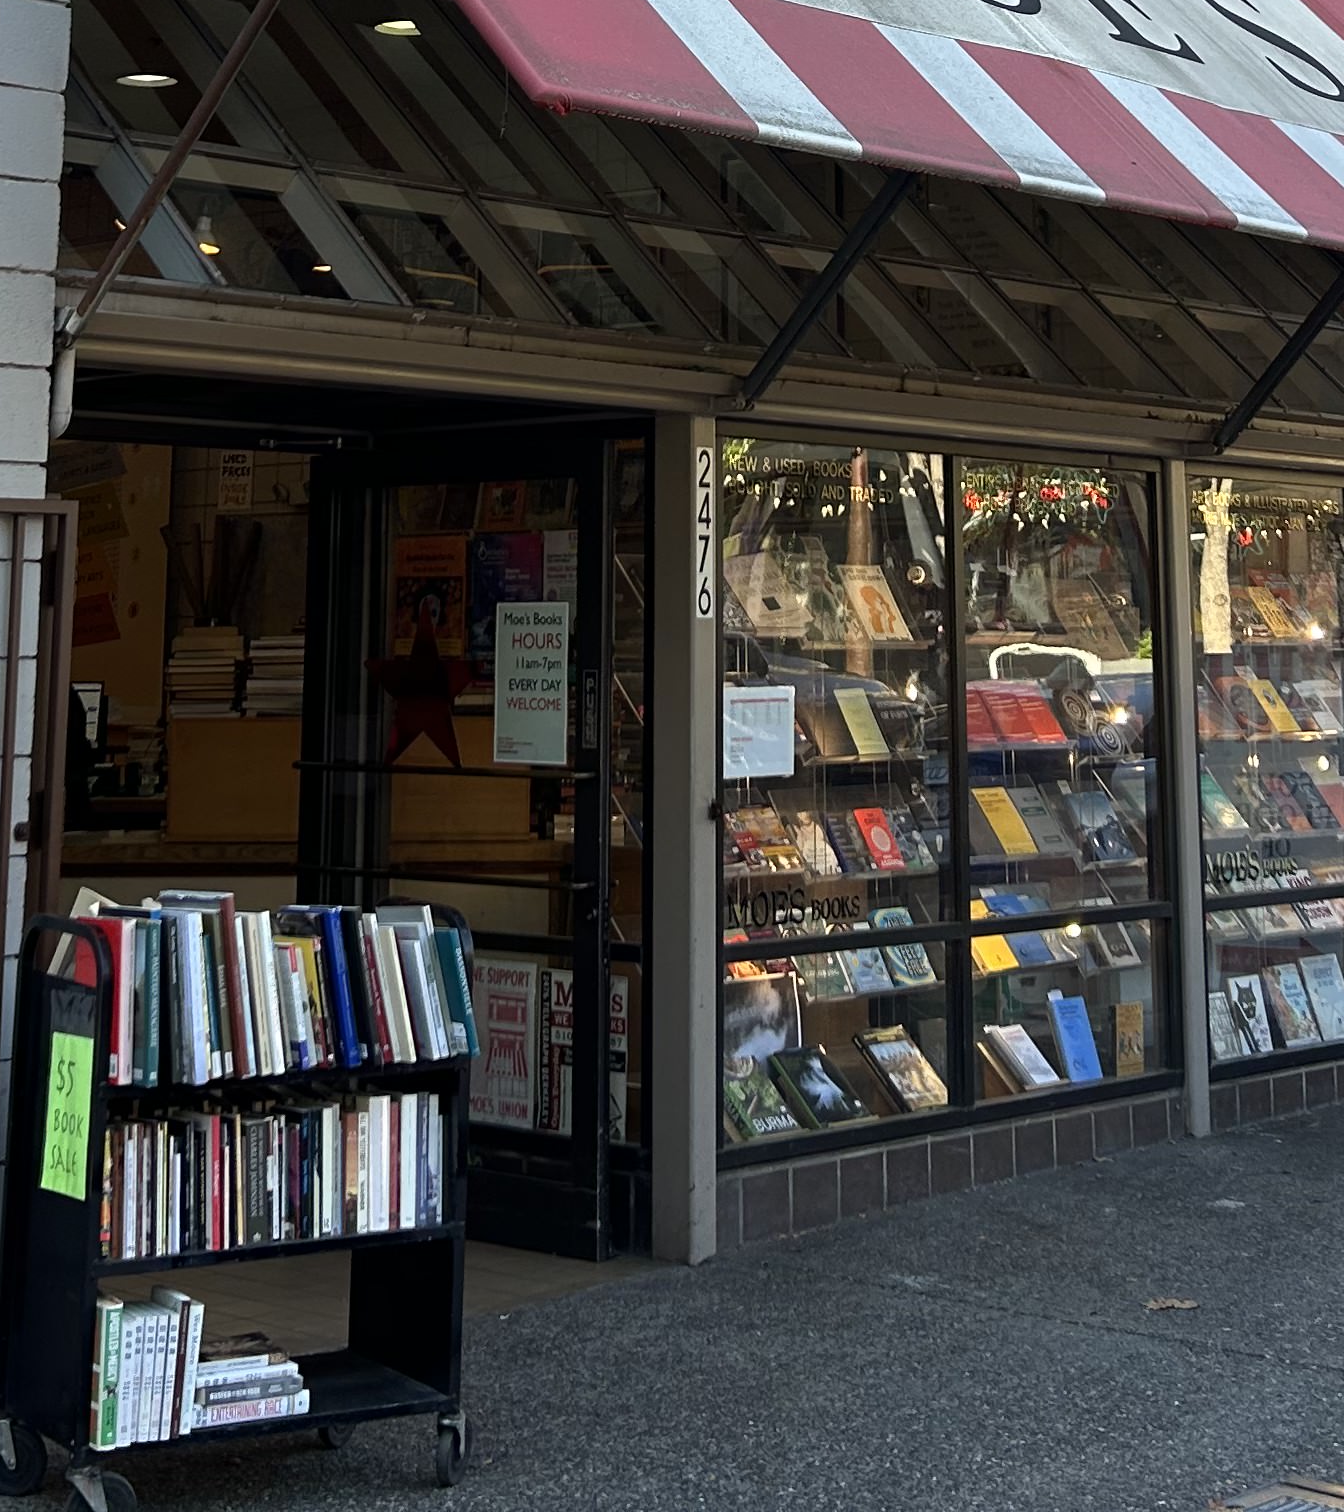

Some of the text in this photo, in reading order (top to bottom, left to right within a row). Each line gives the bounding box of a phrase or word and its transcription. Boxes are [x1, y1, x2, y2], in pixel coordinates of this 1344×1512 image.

[729, 454, 757, 472] NEW
[762, 456, 771, 473] &
[814, 460, 853, 478] BOOKS
[821, 483, 846, 500] AND
[849, 486, 895, 504] TRADED
[697, 449, 712, 616] 2476
[503, 612, 563, 627] Moe's Books
[512, 632, 563, 650] HOURS
[516, 656, 562, 673] 11am-7pm
[509, 678, 562, 692] EVERY DAY
[506, 697, 562, 711] WELCOME
[1205, 843, 1260, 885] MOE'S
[726, 882, 861, 930] MOE'S BOOKS
[487, 967, 531, 988] SUPPORT
[56, 1054, 76, 1099] $5
[498, 1097, 529, 1118] UNION
[53, 1107, 85, 1139] BOOK
[752, 1113, 799, 1133] BURMA
[49, 1143, 77, 1177] SALE
